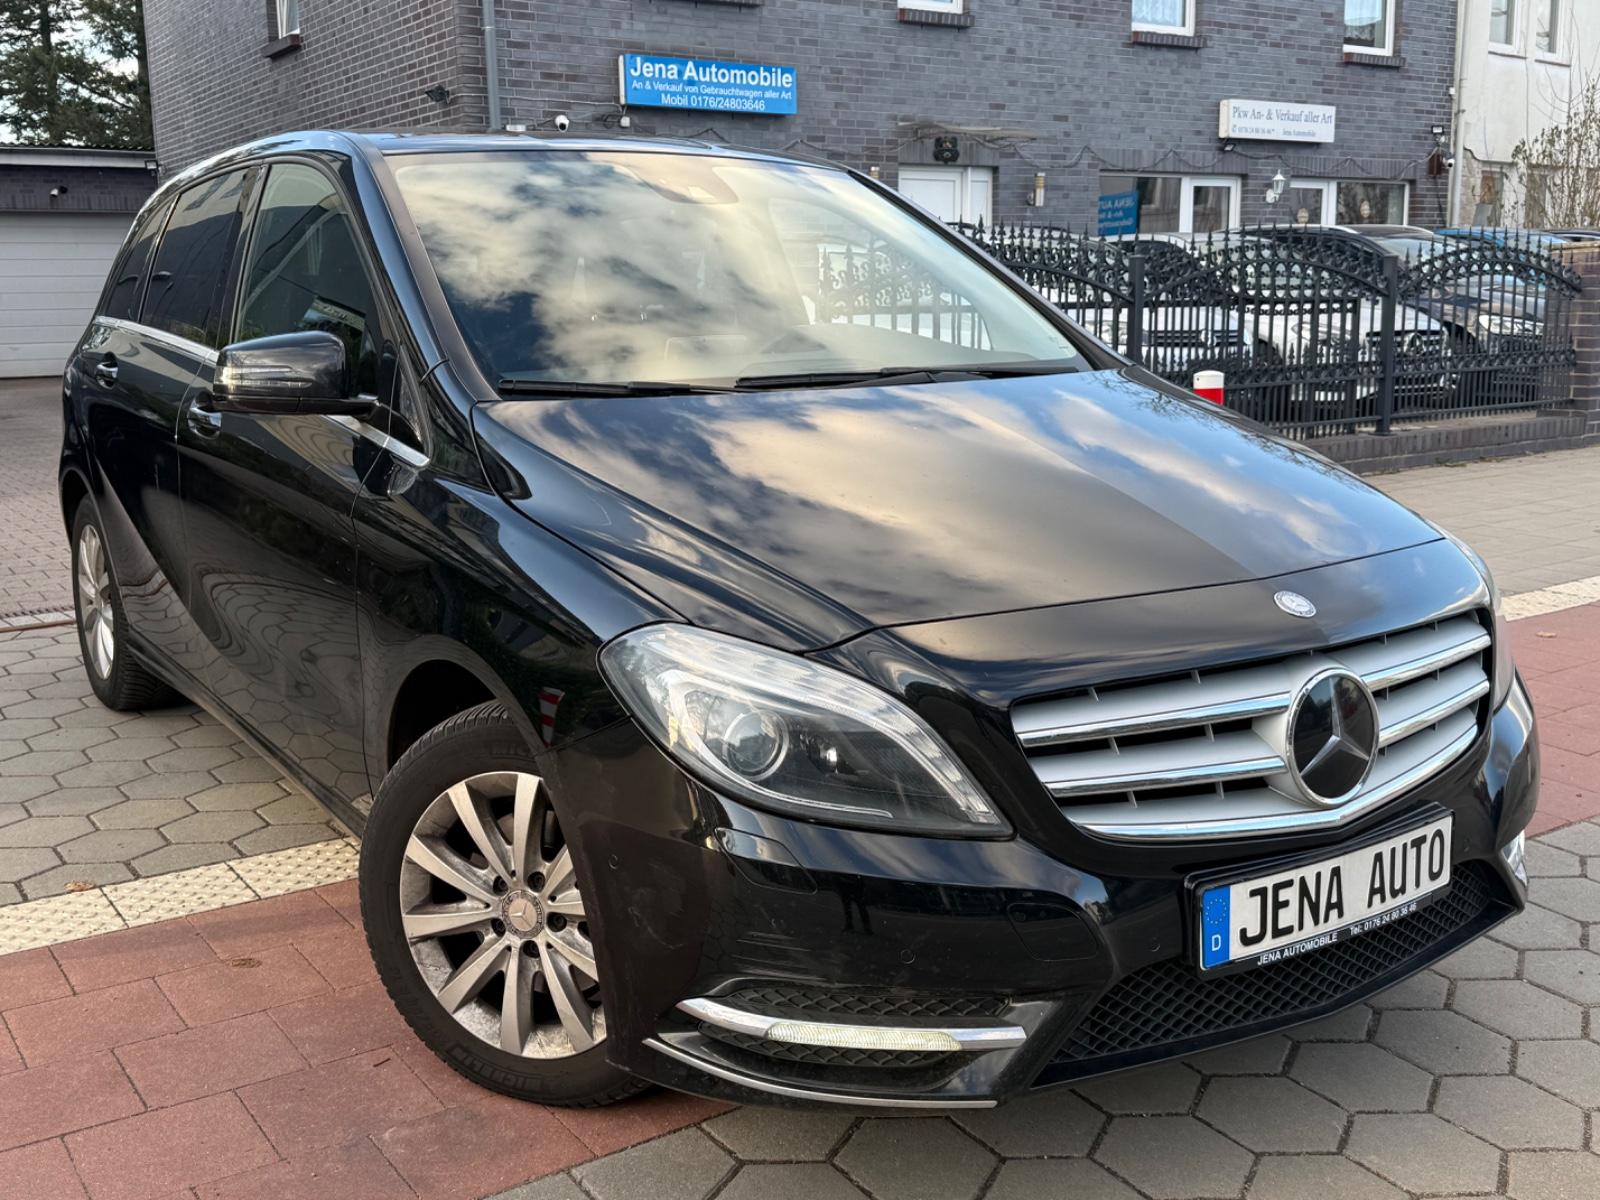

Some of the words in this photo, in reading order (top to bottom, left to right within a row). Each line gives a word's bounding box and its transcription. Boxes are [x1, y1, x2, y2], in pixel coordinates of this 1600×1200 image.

[630, 57, 678, 80] Jena
[683, 60, 793, 88] Automobile
[632, 80, 643, 89] An
[644, 81, 651, 90] &
[653, 81, 683, 92] Verkauf
[684, 85, 698, 93] von
[700, 85, 762, 99] Gebrauchtwagen
[764, 89, 780, 98] aller
[781, 91, 792, 100] Art
[661, 94, 688, 106] Mobil
[691, 96, 765, 111] 0176/24803646
[1232, 106, 1249, 119] Pkw
[1250, 108, 1264, 120] An-
[1266, 108, 1273, 121] &
[1275, 109, 1304, 122] Verkauf
[1304, 111, 1320, 123] aller
[1320, 113, 1333, 124] Art
[1239, 865, 1344, 948] JENA
[1367, 828, 1445, 909] AUTO
[1211, 934, 1222, 952] D
[1257, 951, 1282, 966] JENA
[1282, 931, 1338, 959] AUTOMOBILE
[1350, 924, 1362, 936] Tel:
